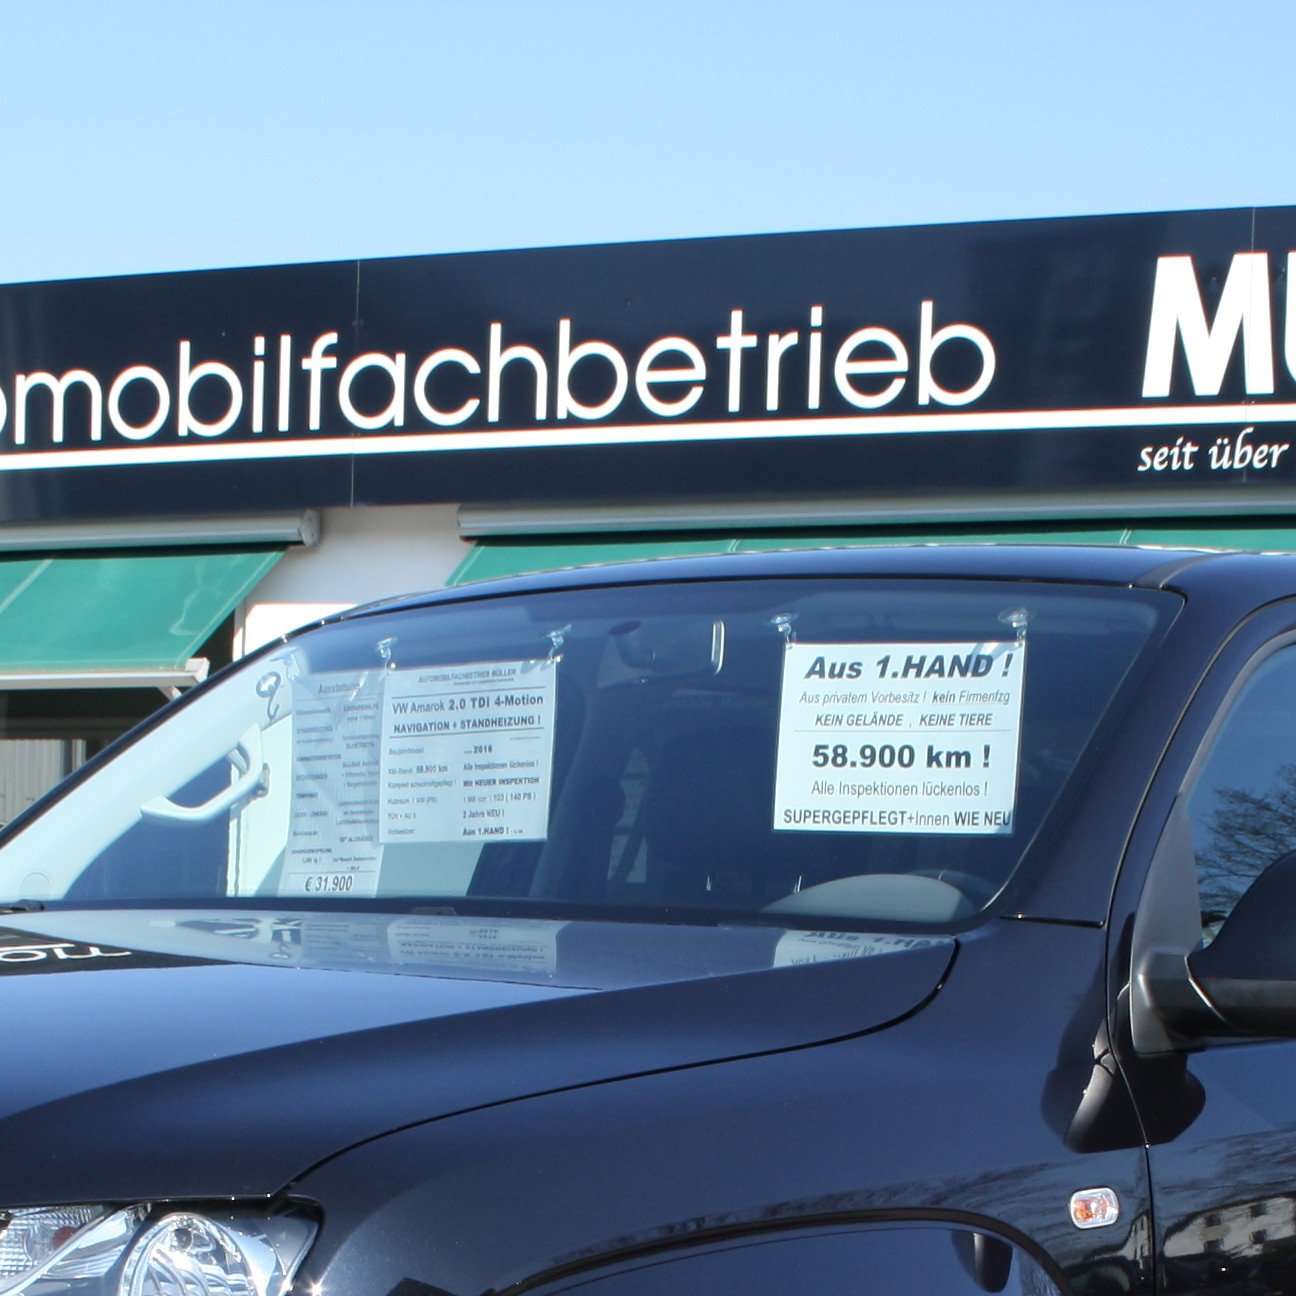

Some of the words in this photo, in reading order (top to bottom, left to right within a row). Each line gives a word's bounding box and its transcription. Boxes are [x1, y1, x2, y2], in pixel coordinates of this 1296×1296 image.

[1137, 437, 1198, 472] seit
[1208, 426, 1287, 471] über
[804, 656, 863, 679] Aus
[875, 654, 993, 678] 1.HAND
[1001, 653, 1013, 678] !
[393, 702, 408, 715] VW
[410, 700, 445, 714] Amarok
[448, 698, 466, 711] 2.0
[470, 695, 490, 709] TDI
[494, 694, 544, 708] 4-Motion
[799, 691, 820, 704] Aus
[823, 690, 867, 707] privatem
[872, 690, 919, 703] Vorbesitz
[932, 689, 956, 703] kein
[394, 719, 450, 734] NAVIGATION
[460, 715, 535, 730] STANDHEIZUNG
[815, 713, 843, 726] KEIN
[846, 711, 904, 726] GELÄNDE
[919, 713, 955, 726] KEINE
[959, 712, 993, 726] TIERE
[812, 744, 915, 769] 58.900
[926, 744, 971, 769] km
[982, 744, 991, 769] !
[811, 780, 835, 796] Alle
[839, 780, 918, 798] Inspektionen
[922, 780, 980, 797] lückenlos
[954, 810, 980, 826] WIE
[983, 810, 1011, 826] NEU
[315, 875, 353, 892] 31.900
